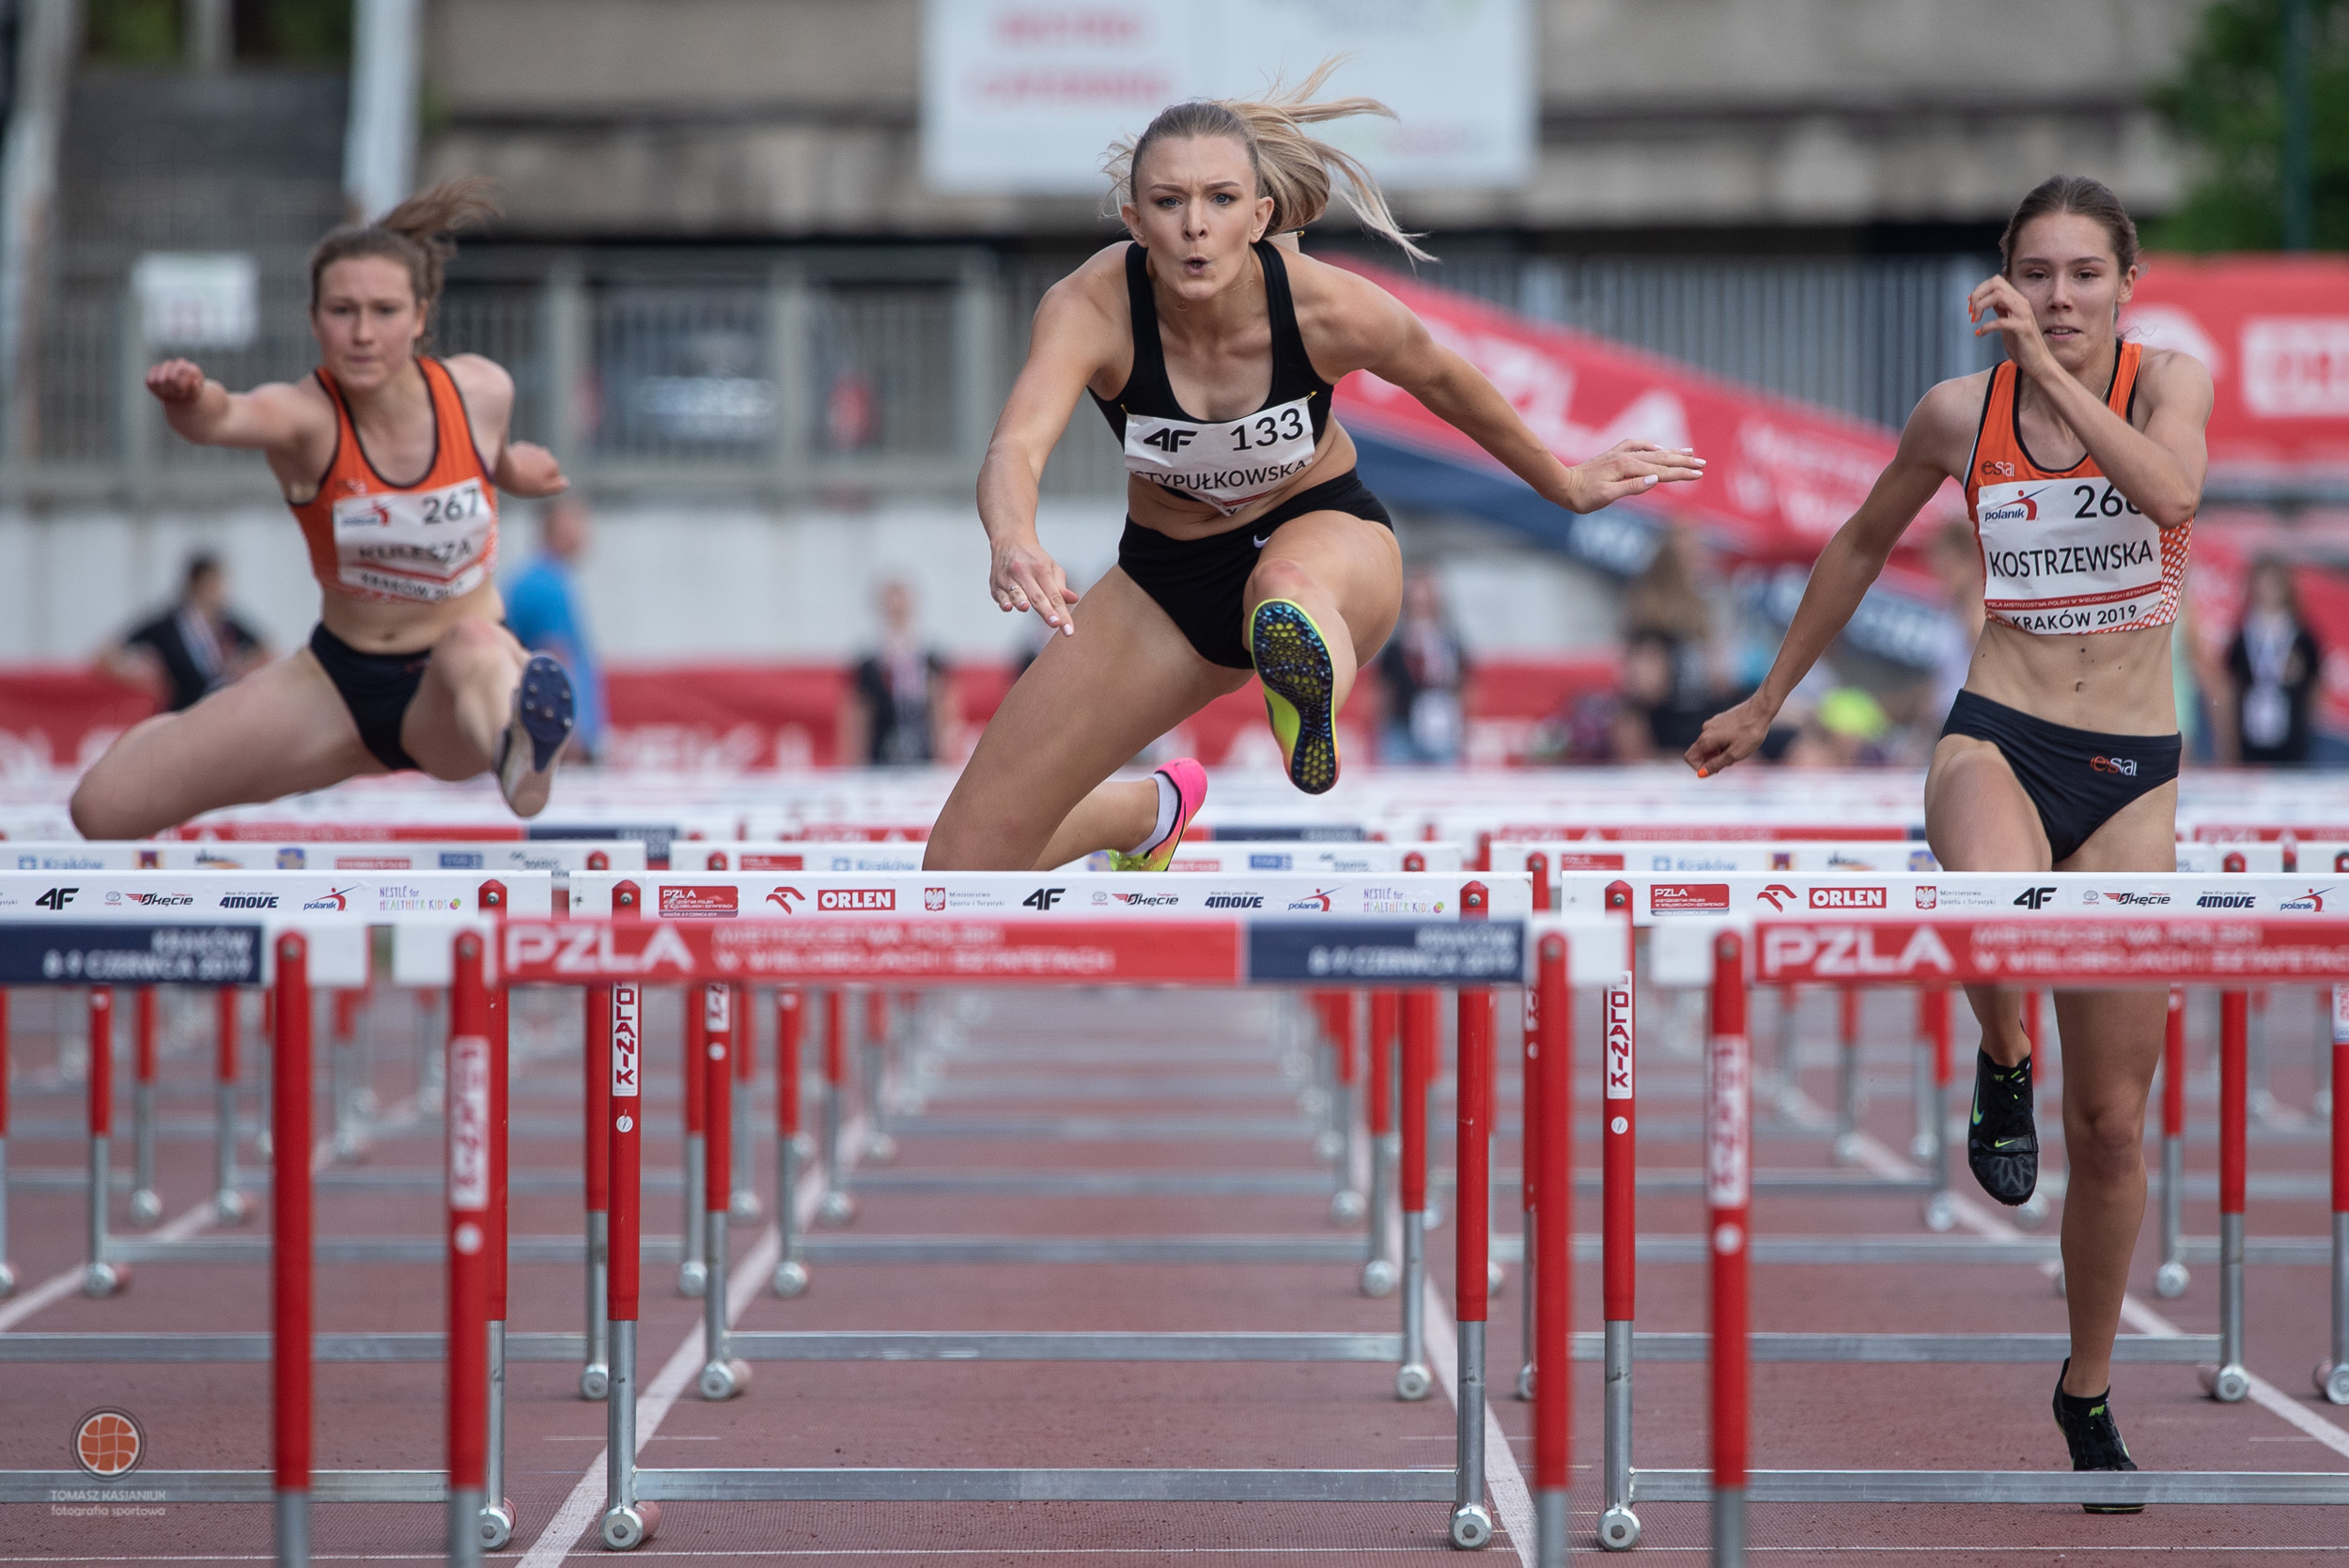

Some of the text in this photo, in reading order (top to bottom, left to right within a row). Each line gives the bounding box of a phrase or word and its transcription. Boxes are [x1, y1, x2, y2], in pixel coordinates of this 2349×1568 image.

[1230, 408, 1304, 451] 133
[1143, 427, 1198, 453] 4F
[1135, 459, 1306, 490] TYPUŁKOWSKA
[424, 487, 478, 525] 267
[1984, 508, 2025, 522] polanik
[1989, 539, 2154, 578] KOSTRZEWSKA
[2012, 604, 2137, 630] KRAKÓW 2019
[35, 888, 80, 910] 4F
[380, 885, 420, 897] NESTLÉ for
[663, 889, 696, 899] PZLA
[1022, 888, 1066, 910] 4F
[1363, 887, 1404, 899] NESTLÉ for
[1655, 888, 1688, 897] PZLA
[1812, 890, 1883, 906] ORLEN
[2013, 887, 2058, 909] 4F
[219, 896, 279, 908] 4MOVE
[303, 901, 337, 911] polanik
[380, 900, 448, 911] HEALTHIER KIDS
[821, 892, 891, 908] ORLEN
[1204, 896, 1264, 908] 4MOVE
[1287, 901, 1322, 911] polanik
[1363, 902, 1431, 913] HEALTHIER KIDS
[2196, 896, 2256, 908] 4MOVE
[2279, 901, 2314, 911] polanik
[505, 924, 696, 973] PZLA
[1763, 924, 1955, 974] PZLA
[614, 983, 637, 1085] OLANIK
